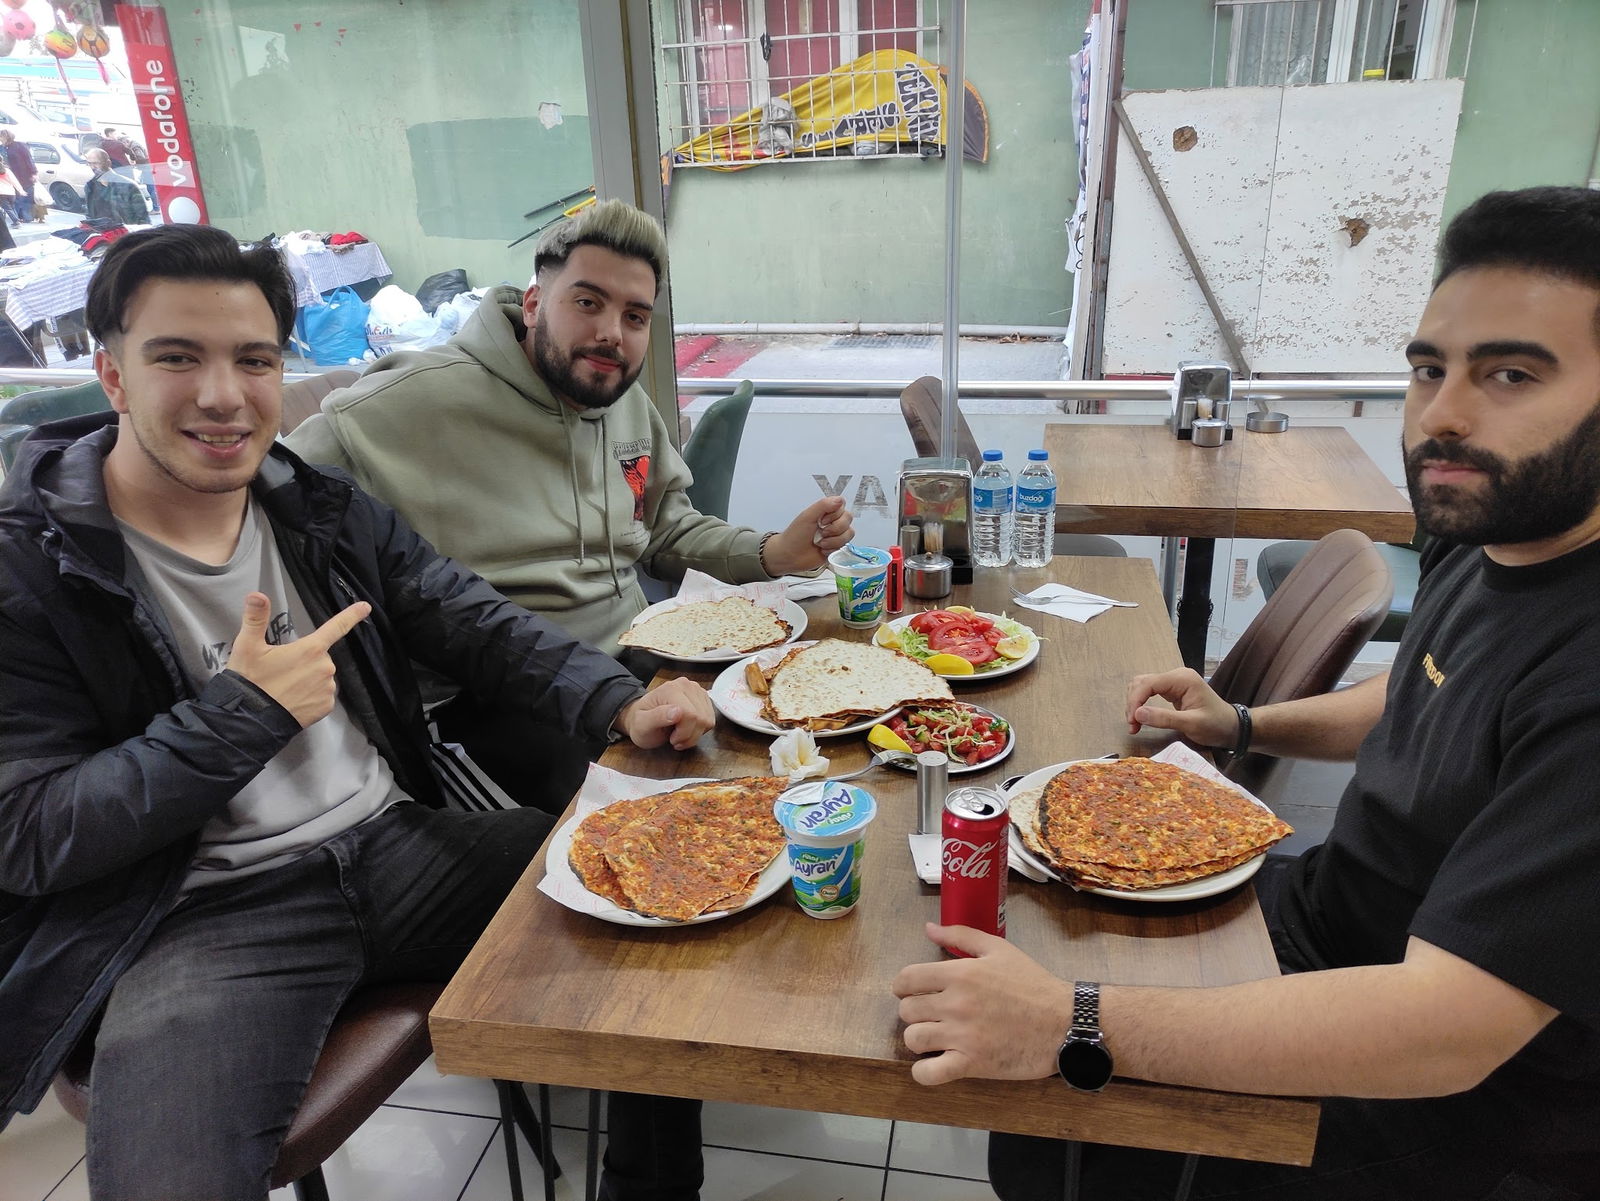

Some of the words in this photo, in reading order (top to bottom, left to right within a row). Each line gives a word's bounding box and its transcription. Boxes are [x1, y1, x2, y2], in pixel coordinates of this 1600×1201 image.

[145, 59, 187, 187] vodafone
[800, 788, 852, 828] Ayran
[794, 860, 836, 877] Ayran
[942, 838, 998, 879] Cola
